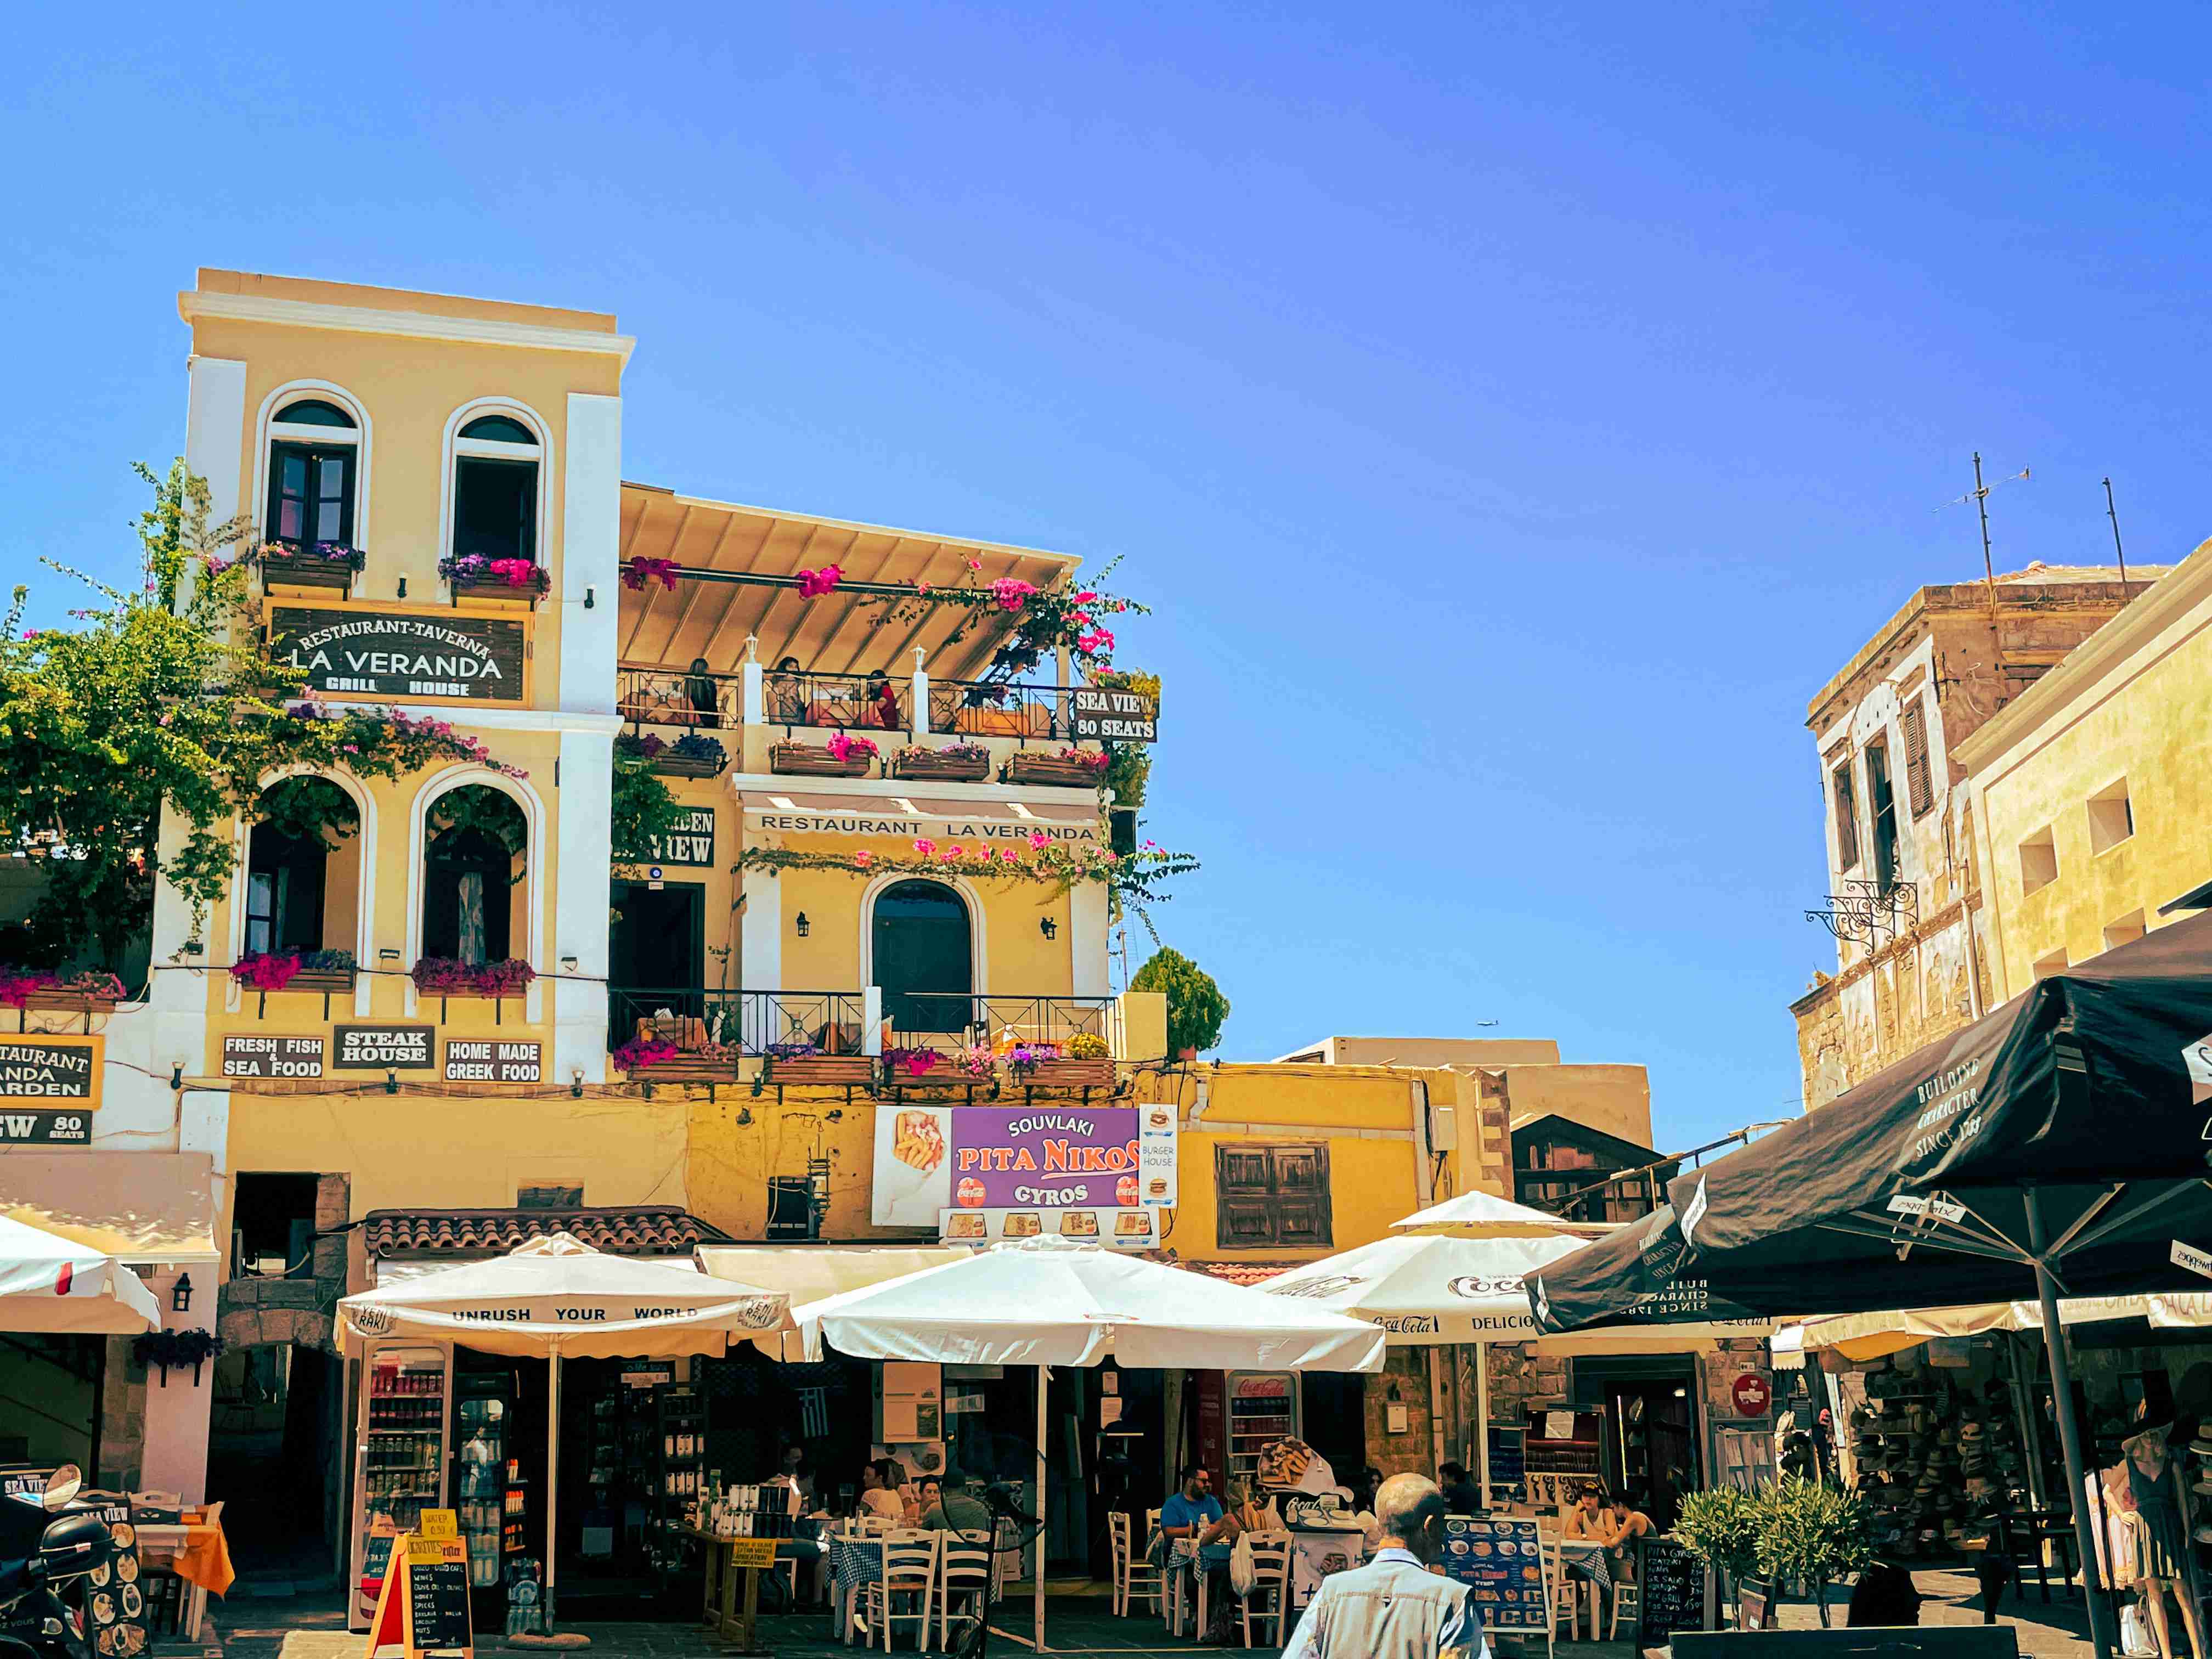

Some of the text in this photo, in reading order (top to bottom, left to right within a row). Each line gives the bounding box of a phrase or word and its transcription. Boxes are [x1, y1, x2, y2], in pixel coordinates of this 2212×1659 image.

[298, 619, 490, 660] RESTAURANT-TAVERNA
[291, 648, 503, 679] LA VERANDA
[326, 677, 470, 696] GRILL HOUSE
[1076, 691, 1109, 712] SEA
[1077, 719, 1154, 738] 80 SEATS
[761, 816, 1094, 840] RESTAURANT LA VERANDA
[225, 1039, 321, 1054] FRESH FISH
[345, 1032, 426, 1046] STEAK
[0, 1046, 88, 1073] TAURANT
[268, 1053, 278, 1062] &
[342, 1047, 426, 1062] HOUSE
[450, 1043, 538, 1060] HOME MADE
[224, 1060, 321, 1076] SEA FOOD
[447, 1063, 540, 1081] GREEK FOOD
[0, 1082, 81, 1096] RDEN
[54, 1116, 82, 1130] 80
[1008, 1115, 1094, 1137] SOUVLAKI
[957, 1139, 1139, 1174] PITA NIKOS
[1142, 1146, 1173, 1156] BURGER
[1143, 1158, 1172, 1167] HOUSE
[1014, 1184, 1089, 1205] GYROS
[359, 1314, 386, 1329] RAKI
[453, 1308, 697, 1321] UNRUSH YOUR WORLD
[1472, 1316, 1533, 1330] DELICIO
[5, 1479, 49, 1493] SEA VIE
